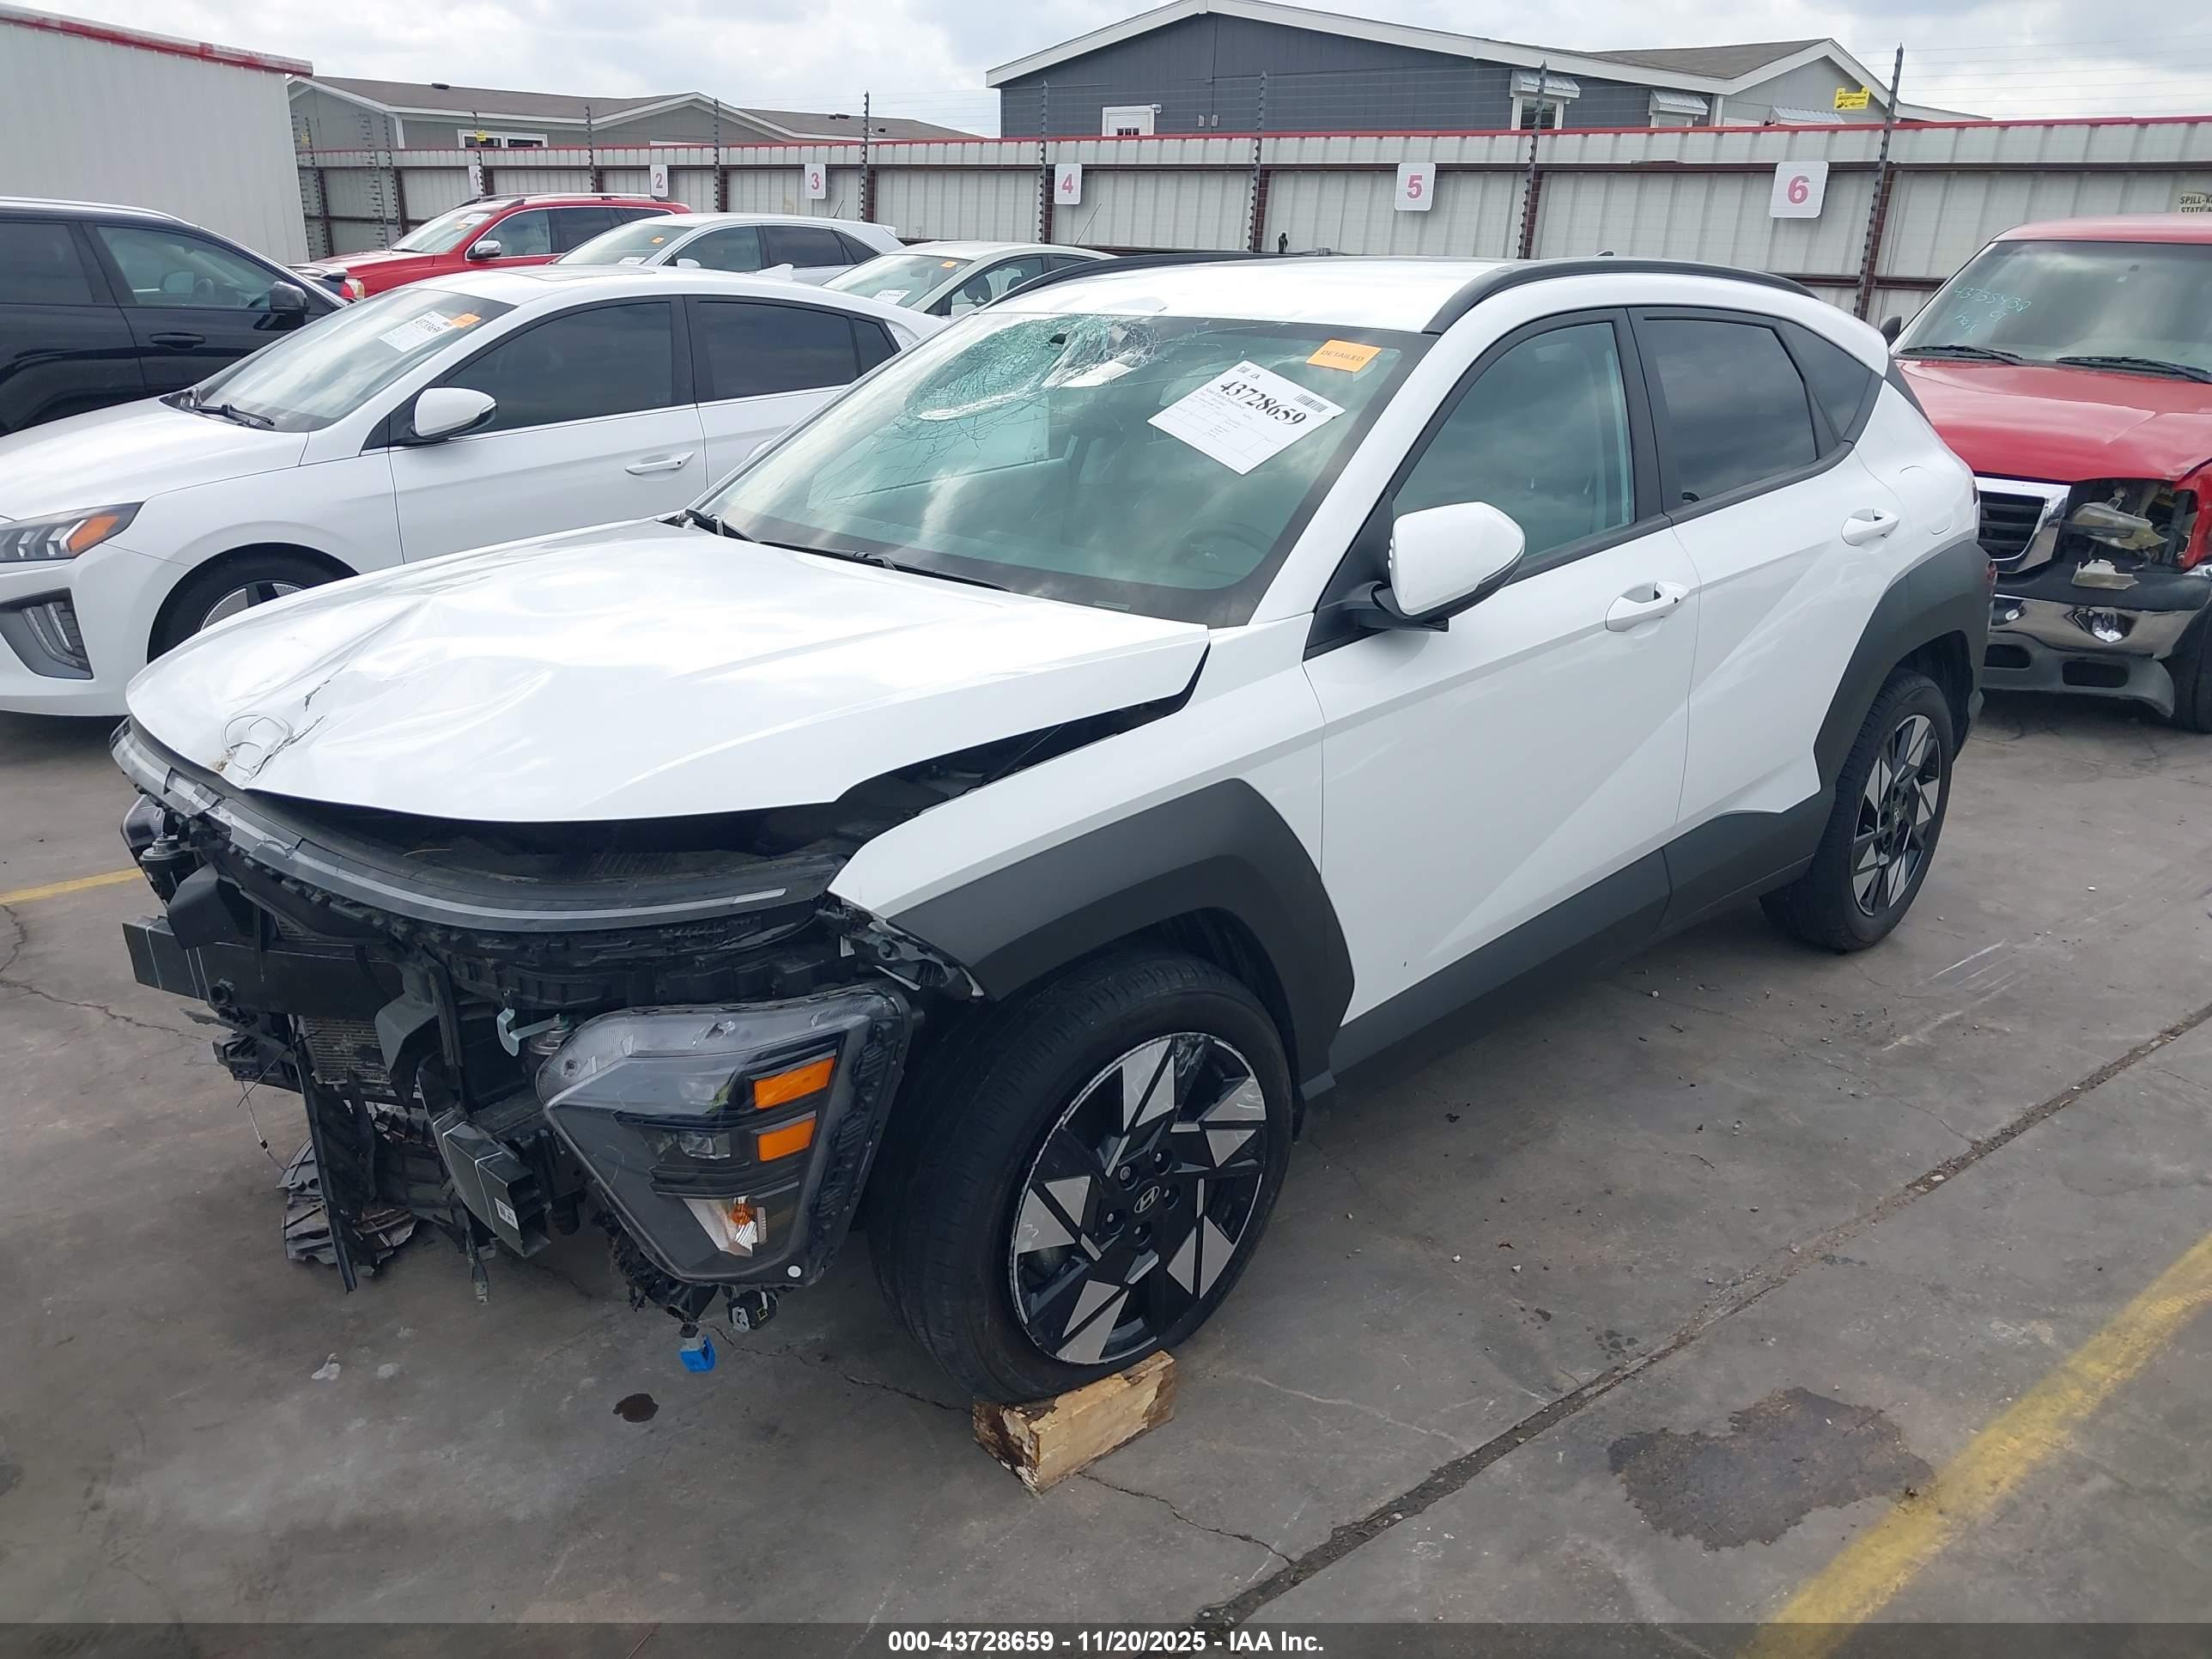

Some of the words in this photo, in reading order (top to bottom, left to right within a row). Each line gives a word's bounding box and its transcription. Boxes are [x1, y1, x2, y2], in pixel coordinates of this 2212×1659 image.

[655, 173, 663, 189] 2
[811, 172, 819, 190] 3
[1061, 173, 1073, 193] 4
[1407, 174, 1422, 198] 5
[1788, 175, 1810, 204] 6
[1321, 349, 1364, 362] DETAILED
[1220, 380, 1307, 425] 43728659
